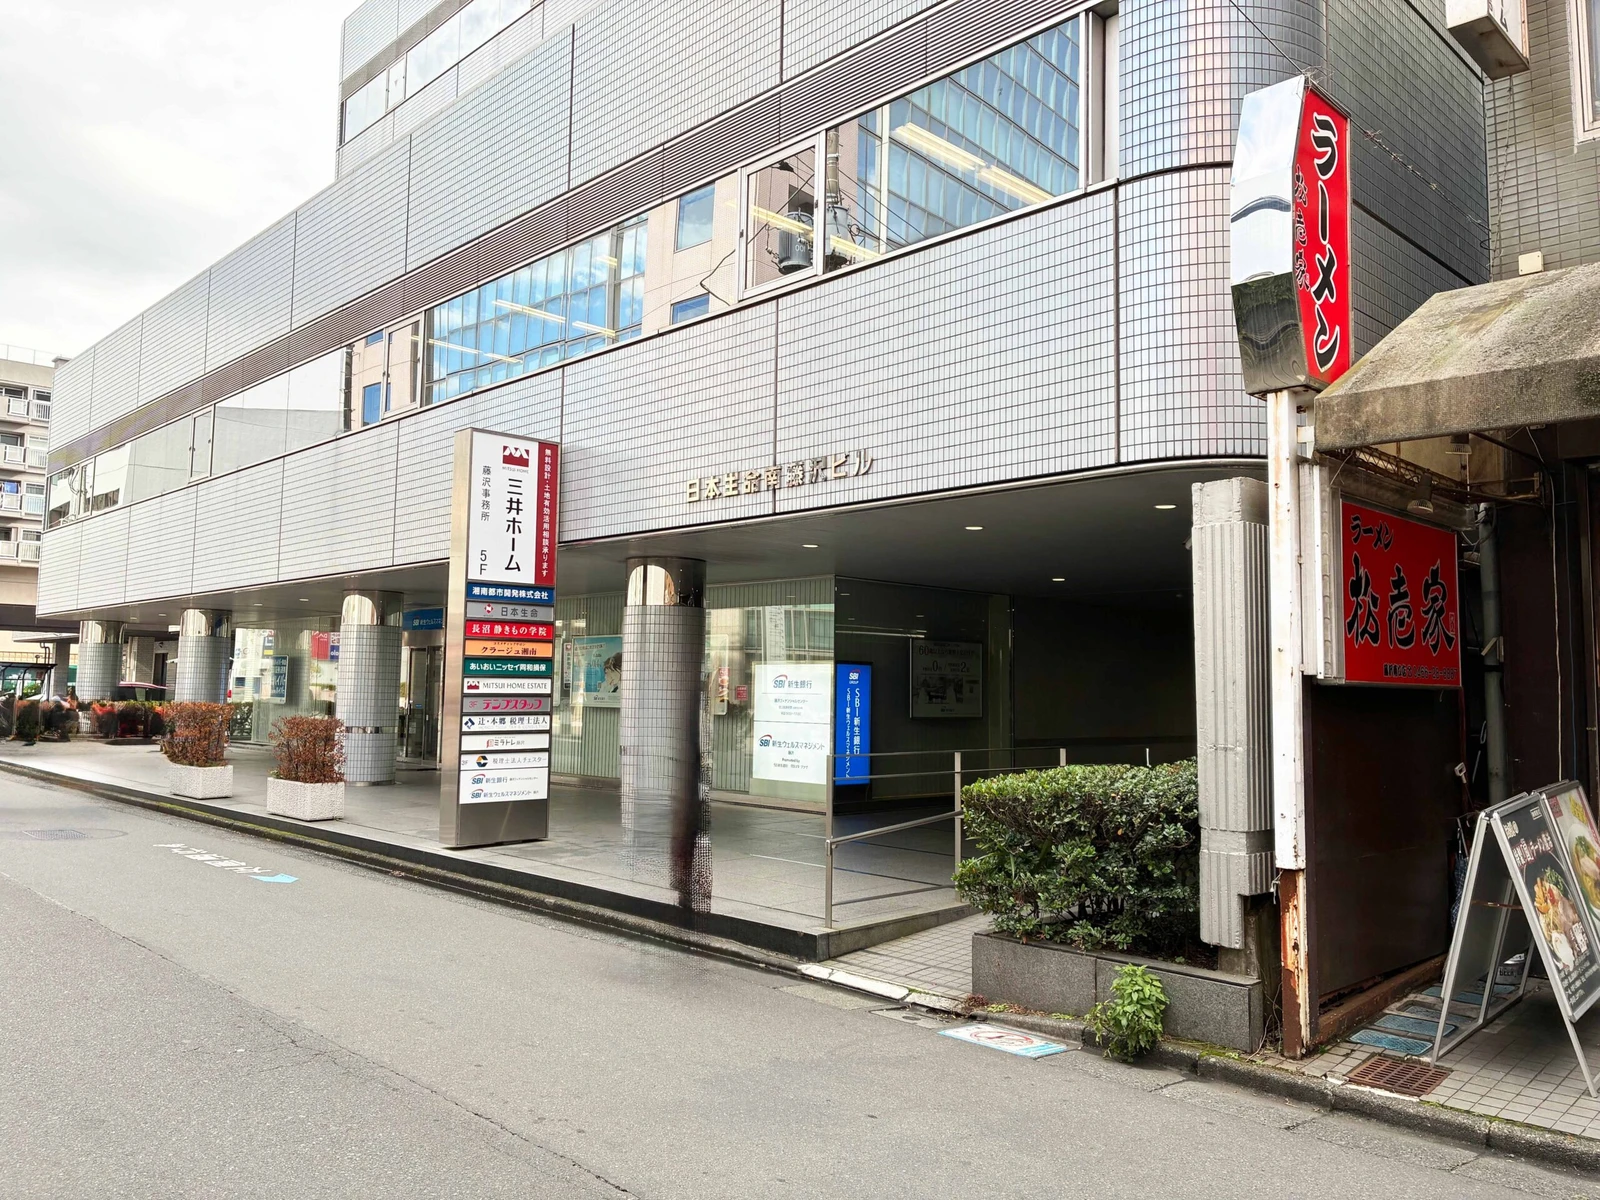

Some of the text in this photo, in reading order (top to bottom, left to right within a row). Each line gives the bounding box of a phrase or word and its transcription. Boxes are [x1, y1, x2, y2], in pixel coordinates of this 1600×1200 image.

[1310, 111, 1340, 373] ラーメン
[686, 448, 874, 503] 日本生命南藤沢ビル
[479, 465, 492, 576] 藤沢事務所 5F
[504, 477, 524, 572] 三井ホーム
[1350, 514, 1394, 552] ラーメン
[472, 586, 549, 600] 湘南都市開発株式会社
[501, 606, 538, 618] 日本生命
[481, 646, 537, 655] クラージュ湘南
[469, 662, 547, 672] あいおいニッセイ同和損保
[849, 672, 860, 680] SBI
[773, 680, 812, 690] SBI 新生銀行
[482, 699, 543, 710] テンプスタッフ
[478, 716, 548, 725] 辻・本郷 税理士法人
[759, 739, 825, 750] SBI 新生ウェルスマネジメント
[471, 777, 484, 785] SBI
[483, 790, 531, 798] 新生ウェルスマネジメント
